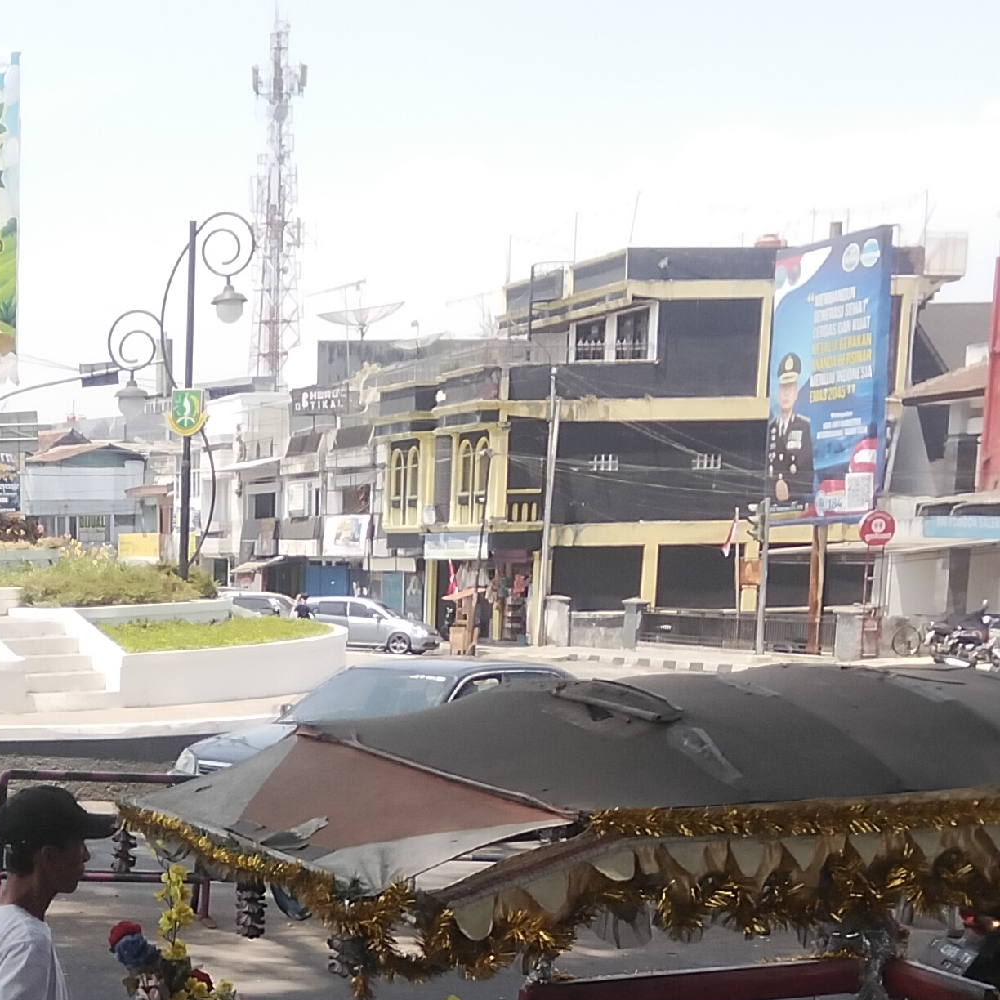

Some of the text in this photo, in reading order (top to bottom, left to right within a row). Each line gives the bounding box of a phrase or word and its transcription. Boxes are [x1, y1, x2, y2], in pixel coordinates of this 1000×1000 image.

[836, 365, 873, 384] INDONESIA
[810, 388, 828, 404] EMAS
[827, 498, 843, 509] 184
